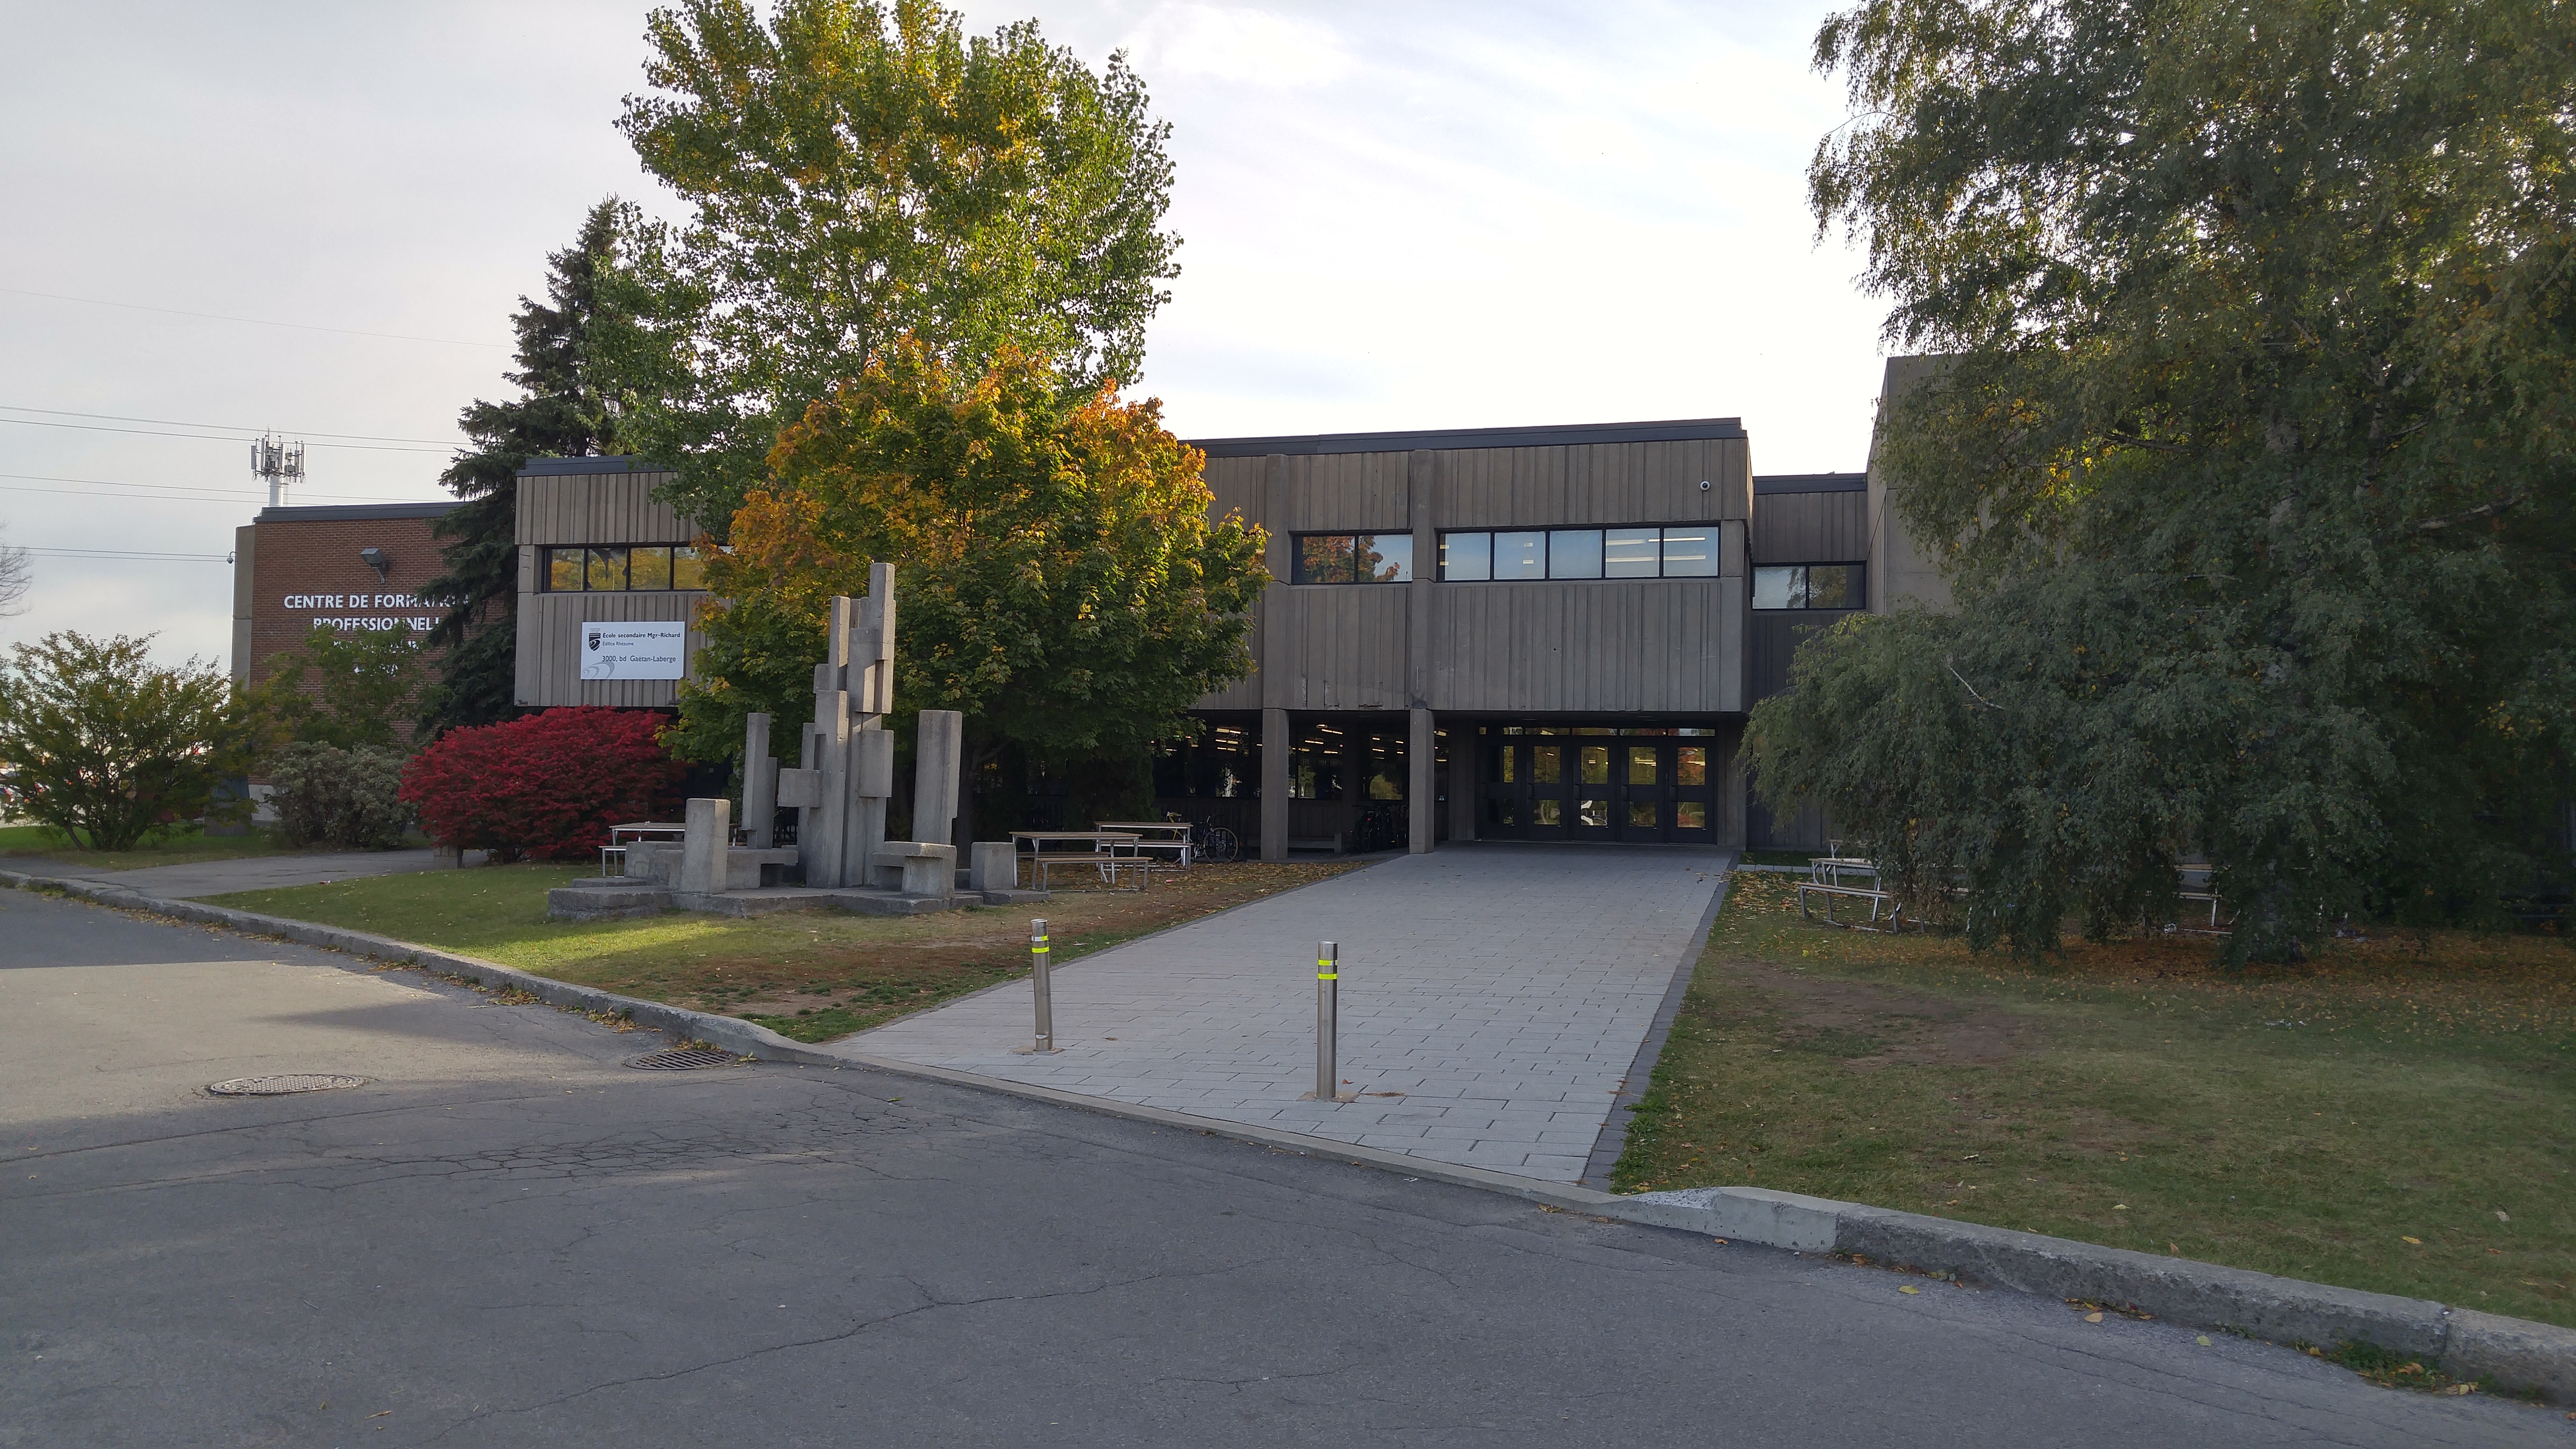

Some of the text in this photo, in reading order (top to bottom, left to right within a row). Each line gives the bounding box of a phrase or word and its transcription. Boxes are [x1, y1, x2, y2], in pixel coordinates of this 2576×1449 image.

[284, 595, 343, 608] CENTRE
[349, 595, 369, 608] DE
[630, 655, 676, 663] Gaétan-Laberge
